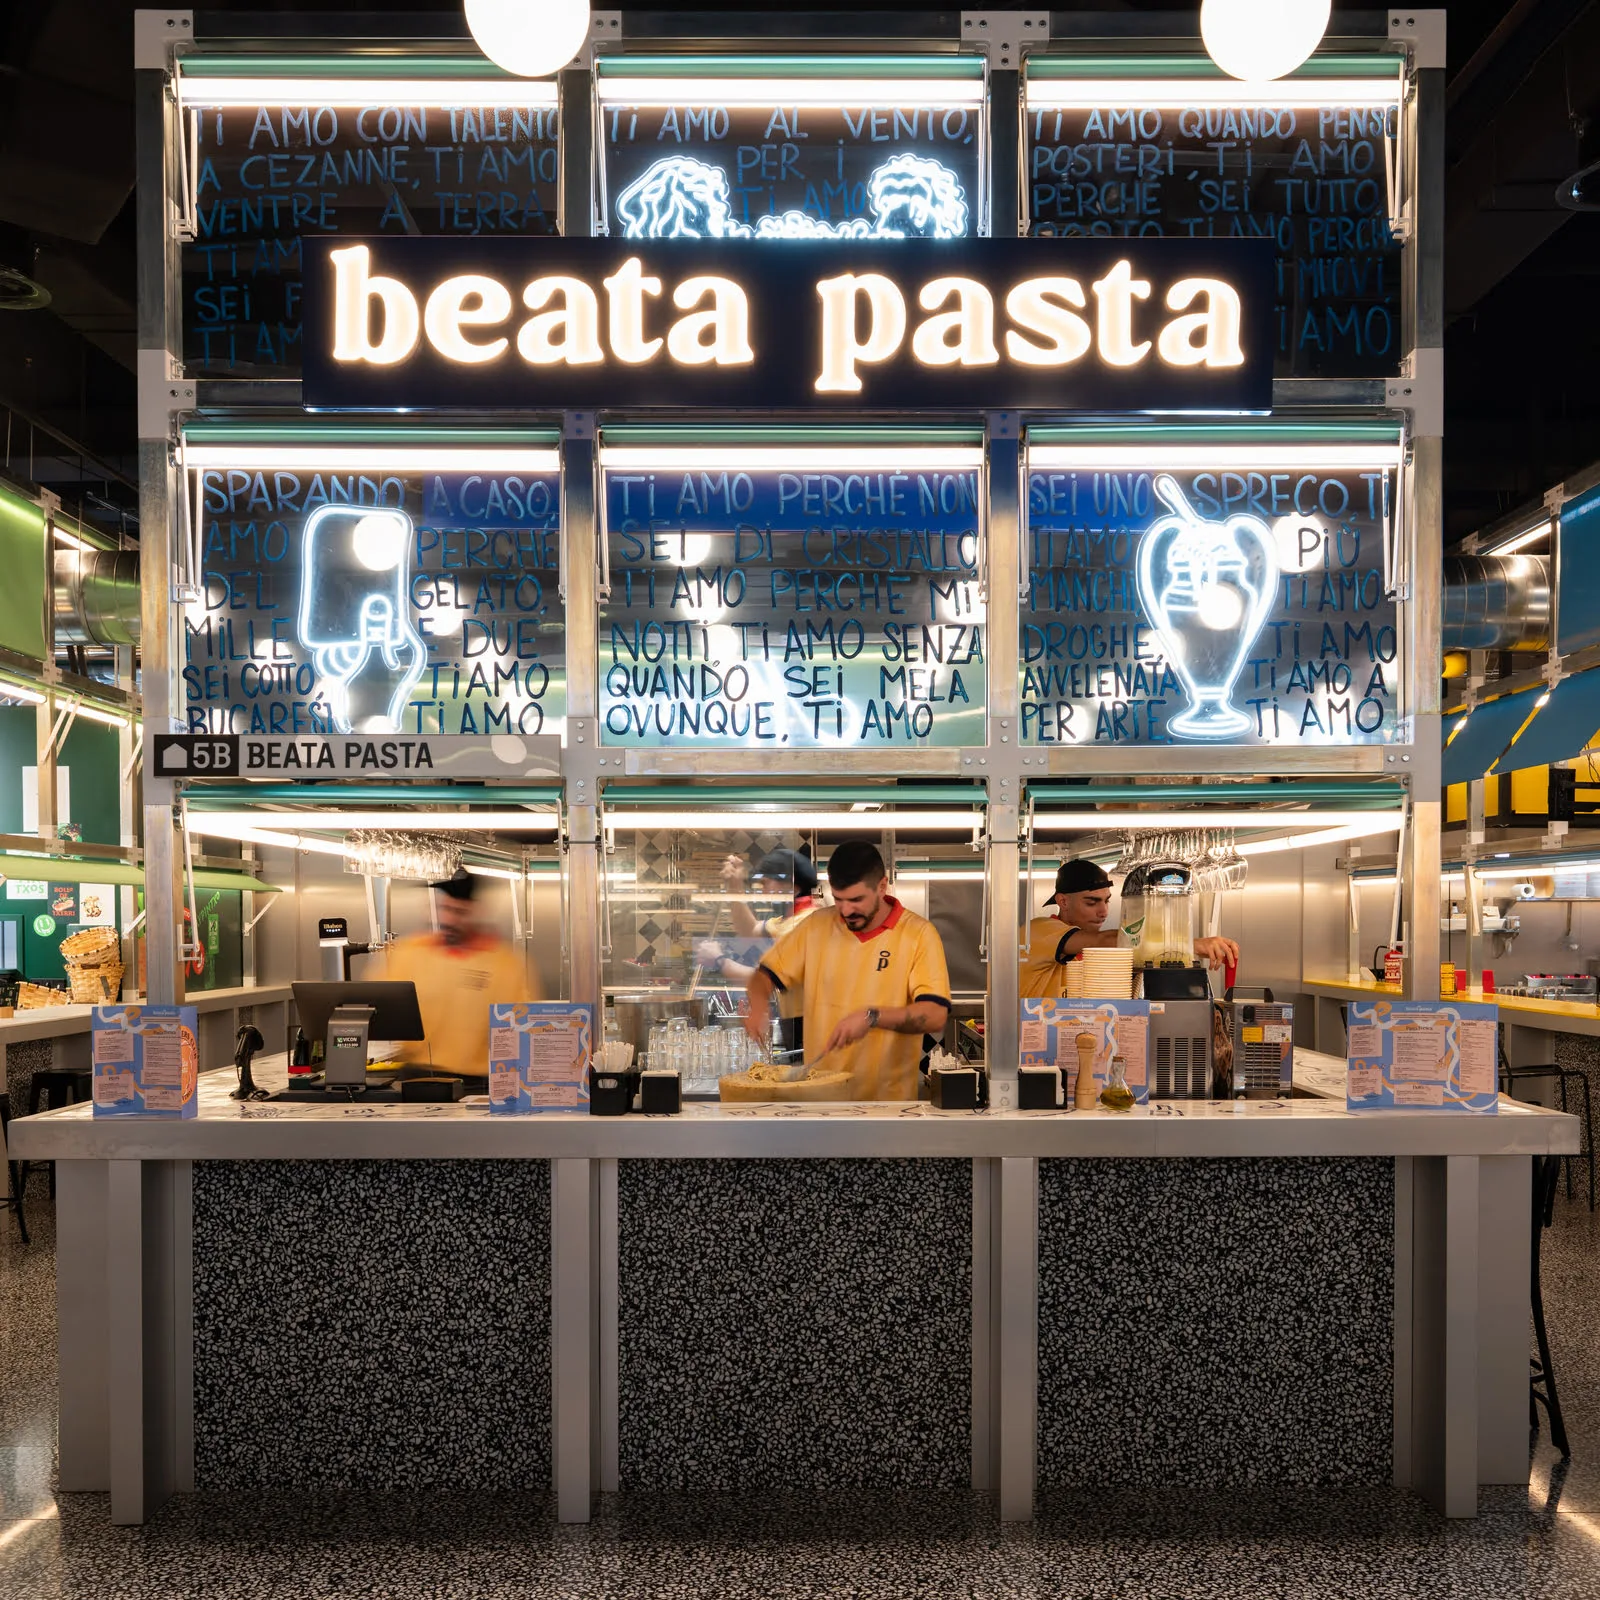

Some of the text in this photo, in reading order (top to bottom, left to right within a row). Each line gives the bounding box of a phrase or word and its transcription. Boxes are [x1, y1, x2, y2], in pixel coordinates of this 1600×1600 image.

[249, 106, 338, 148] AMO
[357, 106, 427, 142] CON
[658, 107, 729, 143] AMO
[764, 106, 808, 139] AL
[841, 107, 974, 144] VENTO,
[1083, 108, 1162, 141] AMO
[1179, 107, 1296, 141] QUANDO
[196, 157, 221, 194] A
[240, 146, 420, 189] CEZANNE,
[477, 146, 557, 183] AMO
[736, 144, 804, 183] PER
[1293, 140, 1374, 175] AMO
[195, 192, 338, 238] VENTRE
[379, 193, 409, 236] A
[804, 180, 865, 220] AMO
[252, 236, 302, 277] AM
[330, 244, 1245, 394] beata pasta
[1299, 305, 1392, 356] AMO
[255, 322, 302, 364] AM
[203, 470, 556, 521] SPARANDO A CASO,
[677, 472, 754, 515] AMO
[917, 473, 977, 516] NON
[1093, 474, 1151, 518] UNO
[1192, 473, 1358, 521] SPRECO,
[203, 521, 289, 563] AMO
[1064, 524, 1132, 567] AMO
[203, 571, 279, 610] DEL
[409, 573, 549, 616] GELATO,
[671, 566, 747, 609] AMO
[1318, 569, 1381, 611] AMO
[463, 618, 539, 659] DUE
[784, 618, 865, 662] AMO
[881, 622, 983, 664] SENZA
[1320, 620, 1397, 663] AMO
[465, 662, 549, 700] AMO
[606, 664, 749, 701] QUANDO
[879, 665, 969, 703] MELA
[1022, 662, 1180, 699] AVVELENATA
[1286, 661, 1351, 694] AMO
[1365, 663, 1389, 698] A
[460, 701, 545, 735] AMO
[605, 701, 788, 743] OVUNQUE,
[861, 699, 933, 739] AMO
[1022, 702, 1076, 741] PER
[1299, 696, 1384, 736] AMO
[193, 742, 434, 769] 5B BEATA PASTA
